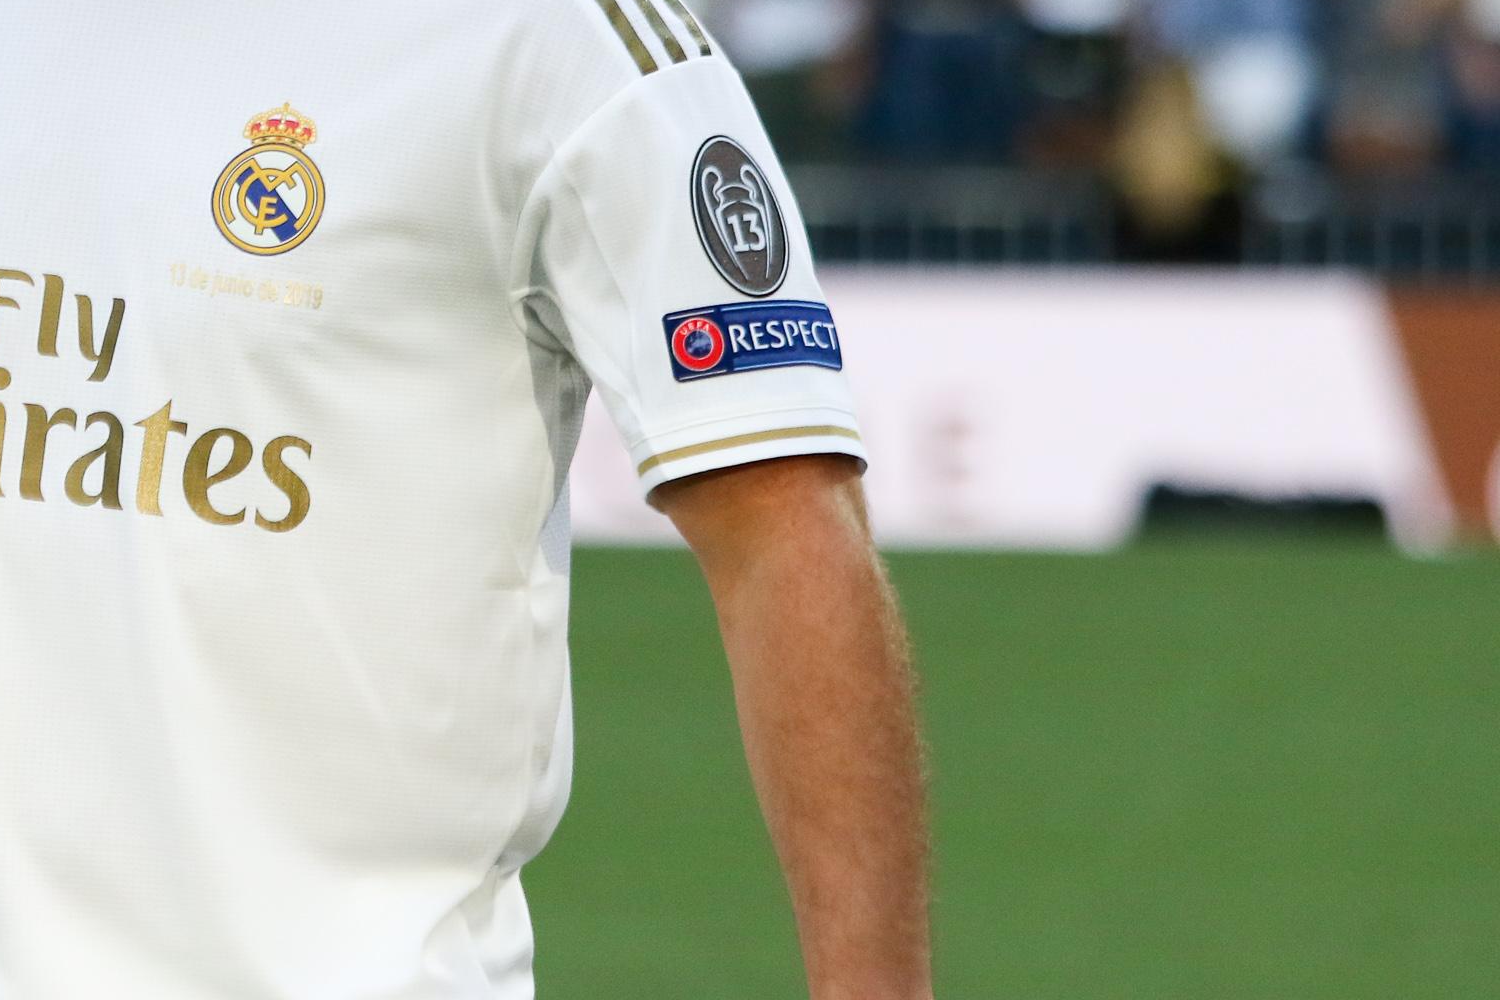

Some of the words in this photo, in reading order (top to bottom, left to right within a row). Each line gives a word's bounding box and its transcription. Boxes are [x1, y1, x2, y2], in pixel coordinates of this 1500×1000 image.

[727, 213, 766, 252] 13
[170, 262, 187, 287] 13
[189, 265, 210, 291] de
[210, 269, 254, 298] junio
[258, 278, 278, 302] de
[283, 280, 324, 310] 2019
[679, 320, 711, 336] UEFA
[728, 319, 838, 353] RESPECT
